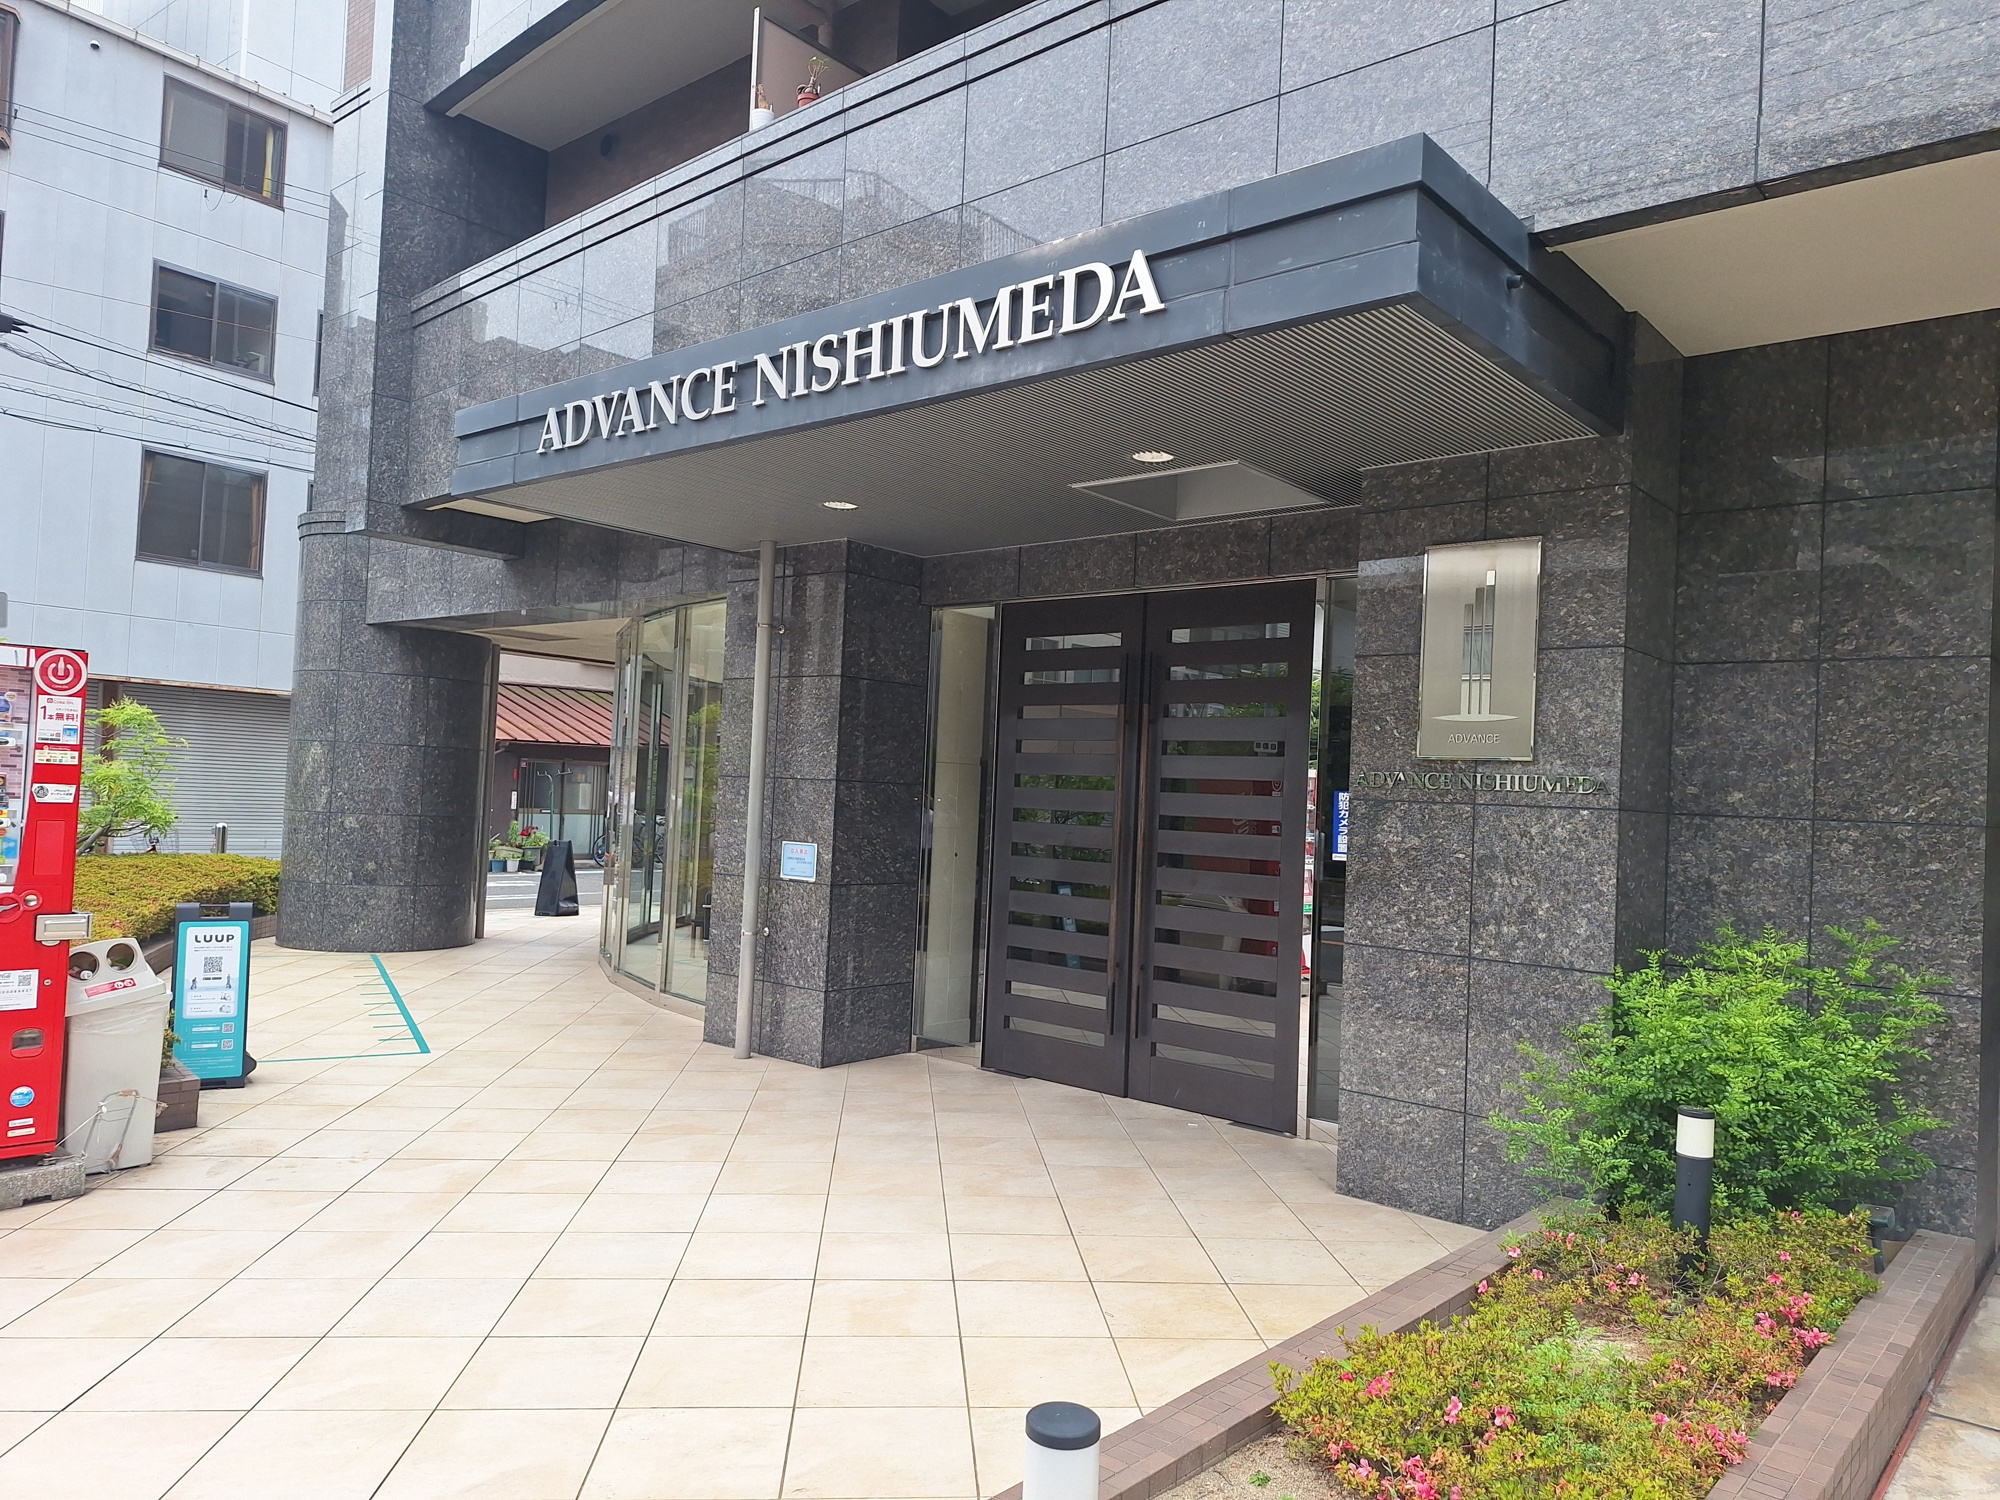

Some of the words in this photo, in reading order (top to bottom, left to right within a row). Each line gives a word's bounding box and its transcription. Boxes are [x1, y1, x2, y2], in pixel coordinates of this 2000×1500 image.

[536, 361, 737, 454] ADVANCE
[752, 249, 1166, 406] NISHIUMEDA
[1448, 733, 1501, 744] ADVANCE
[1356, 771, 1453, 790] ADVANCE
[1458, 772, 1612, 795] NISHIUMEDA
[194, 934, 235, 943] LUUP
